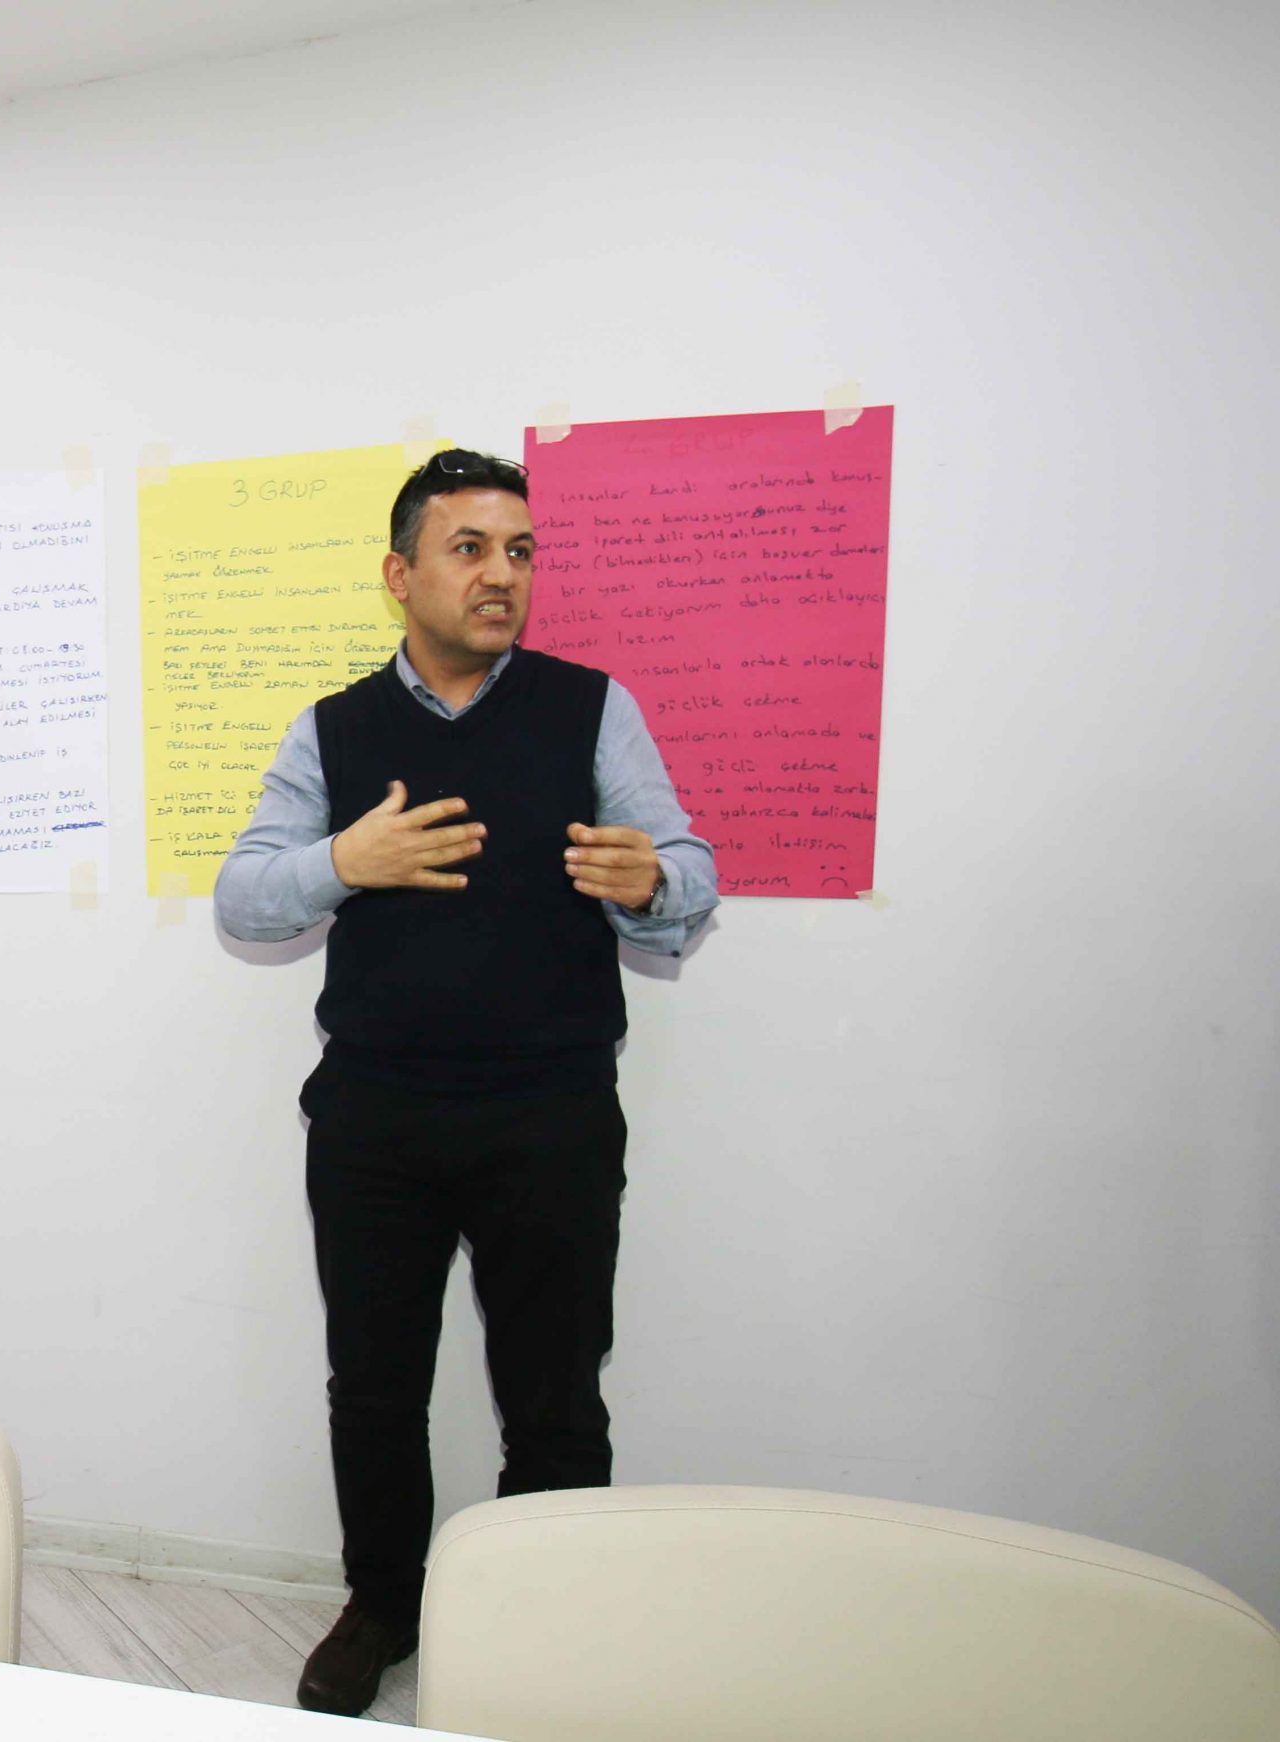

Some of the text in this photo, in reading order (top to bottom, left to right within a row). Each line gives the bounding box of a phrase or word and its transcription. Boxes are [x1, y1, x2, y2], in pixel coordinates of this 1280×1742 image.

[229, 480, 326, 507] 3 GRUP
[53, 597, 97, 608] DEVAM
